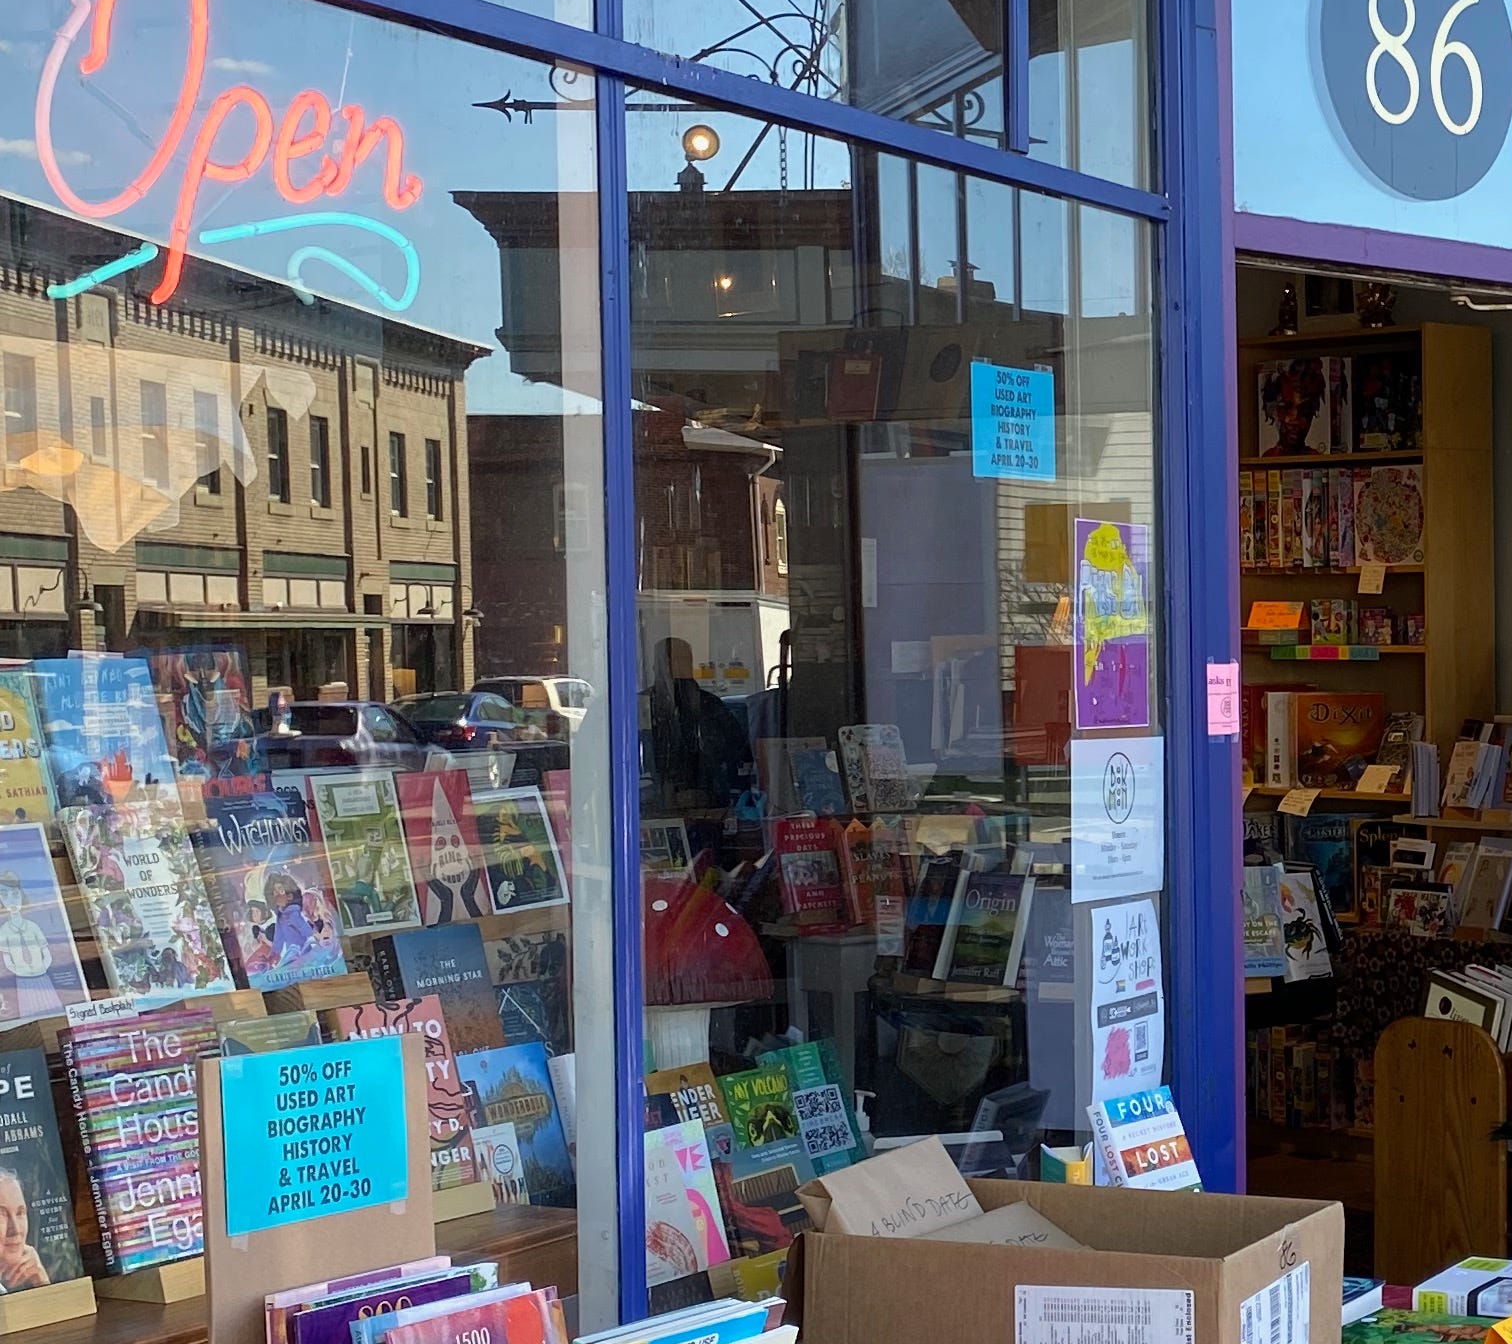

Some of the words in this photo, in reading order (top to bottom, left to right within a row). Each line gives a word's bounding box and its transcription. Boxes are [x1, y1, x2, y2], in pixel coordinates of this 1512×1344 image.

[122, 853, 160, 867] WORLD
[139, 870, 153, 882] OF
[127, 884, 177, 900] WONDERS
[965, 888, 1016, 917] Origin
[440, 958, 457, 969] THE
[1043, 953, 1068, 968] Attic
[417, 973, 461, 989] MORNING
[119, 1030, 182, 1064] The
[109, 1063, 196, 1107] Cand
[278, 1064, 317, 1087] 50%
[321, 1059, 352, 1082] OFF
[276, 1089, 319, 1111] USED
[323, 1084, 356, 1106] ART
[1117, 1093, 1165, 1120] FOUR
[4, 1125, 44, 1143] ABRAMS
[116, 1110, 199, 1149] Hous
[267, 1106, 366, 1138] BIOGRAPHY
[282, 1133, 353, 1161] HISTORY
[1093, 1111, 1109, 1143] FOUR
[1104, 1144, 1117, 1175] LOST
[1135, 1141, 1181, 1169] LOST
[279, 1167, 292, 1188] &
[295, 1158, 360, 1185] TRAVEL
[119, 1171, 201, 1212] Jenni
[267, 1189, 316, 1216] APRIL
[319, 1177, 372, 1203] 20-30
[881, 1195, 926, 1233] BLIND
[926, 1190, 972, 1218] DATE
[148, 1212, 204, 1249] Ega
[1184, 1292, 1193, 1332] Enclosed
